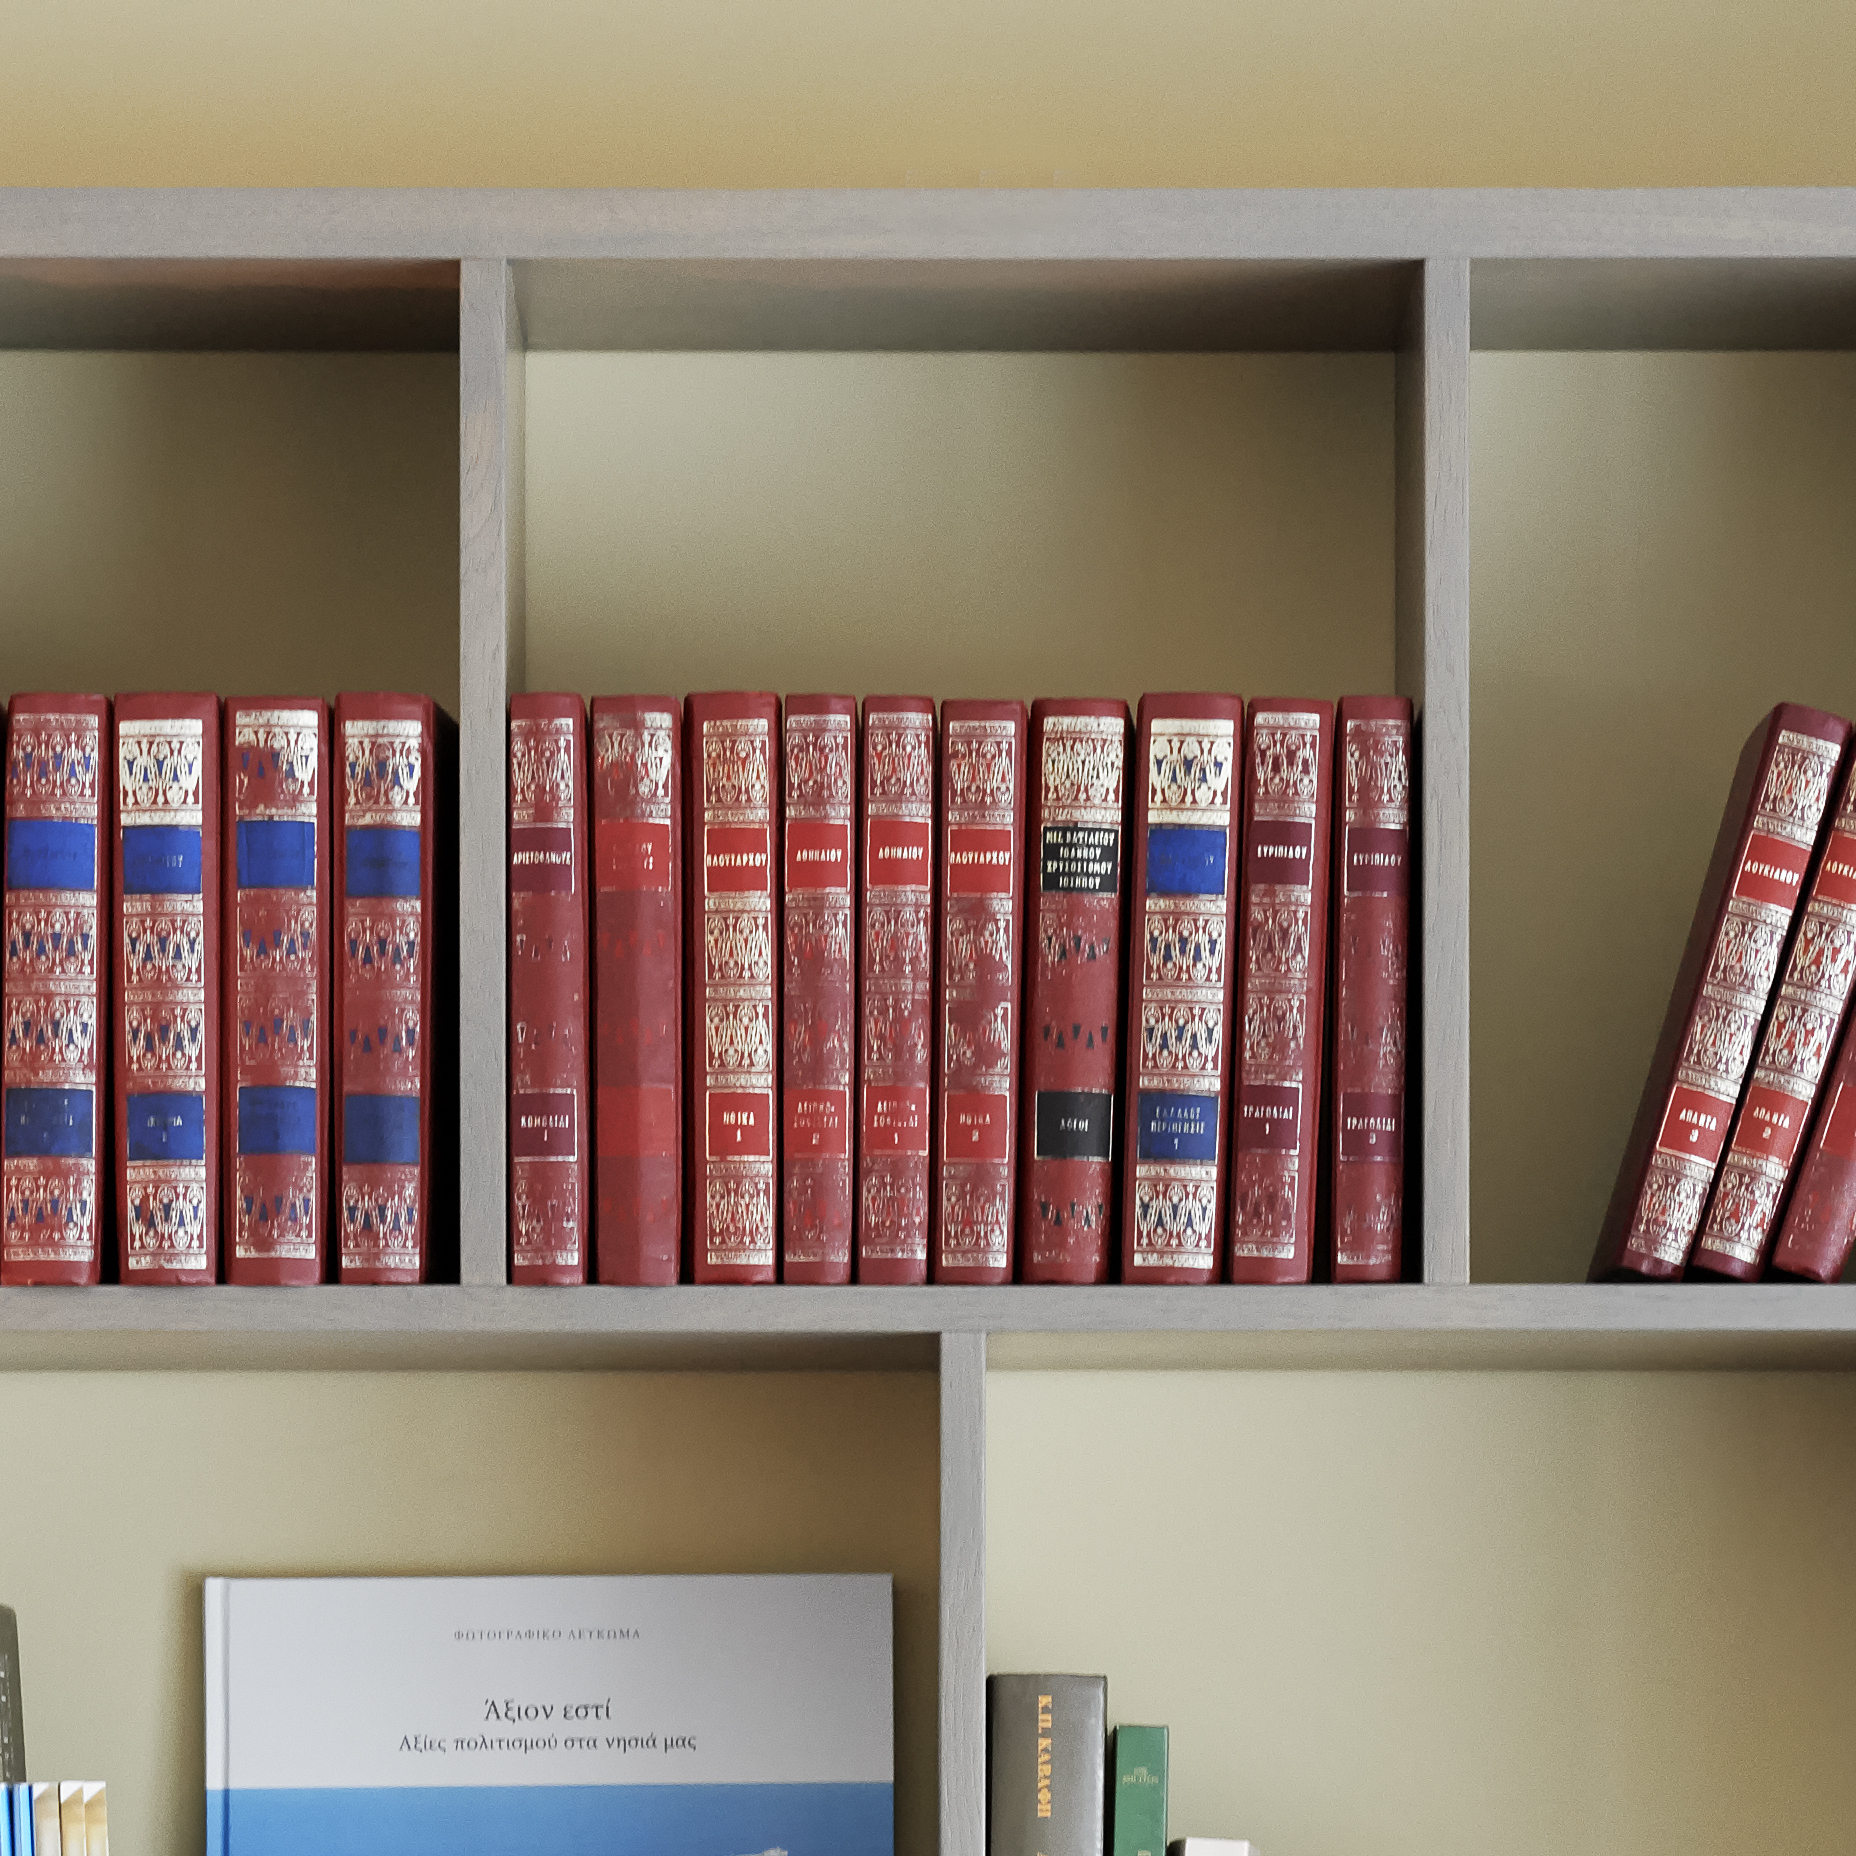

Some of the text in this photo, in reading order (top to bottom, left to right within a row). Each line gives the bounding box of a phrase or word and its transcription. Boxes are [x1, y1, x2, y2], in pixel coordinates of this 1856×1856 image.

[1744, 859, 1800, 887] ΛΟΥΚΙΑΝΟΥ
[453, 1627, 641, 1641] ΦΩΤΟΓΡΑΦΙΚΟ ΛΕΥΚΩΜΑ
[484, 1697, 612, 1724] Άξιον εστί
[399, 1732, 697, 1755] Αξίες πολιτισμού στα νησιά μας
